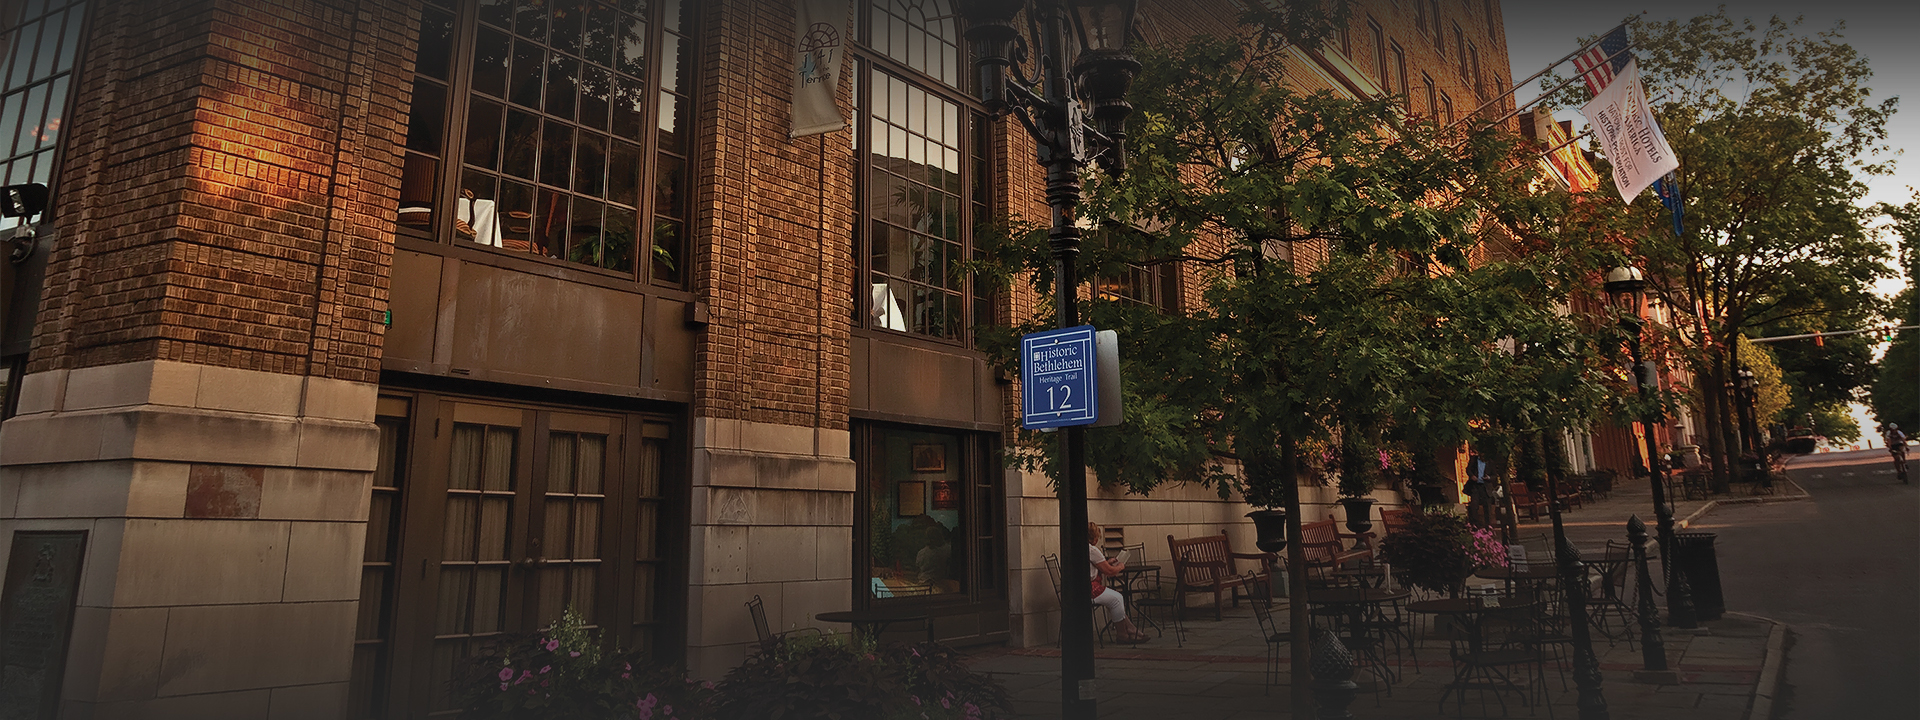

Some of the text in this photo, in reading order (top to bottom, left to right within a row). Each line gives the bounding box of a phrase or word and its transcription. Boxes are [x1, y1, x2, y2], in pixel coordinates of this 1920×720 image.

[1597, 110, 1616, 142] HISTORIC
[1606, 104, 1621, 135] NATION
[1624, 156, 1633, 172] FOR
[1624, 115, 1642, 155] AMERICA
[1638, 126, 1663, 163] HOTELS
[1034, 357, 1083, 373] Bethlehem
[1040, 344, 1078, 362] Historic
[1039, 372, 1078, 384] Heritage Trail
[1046, 384, 1072, 410] 12
